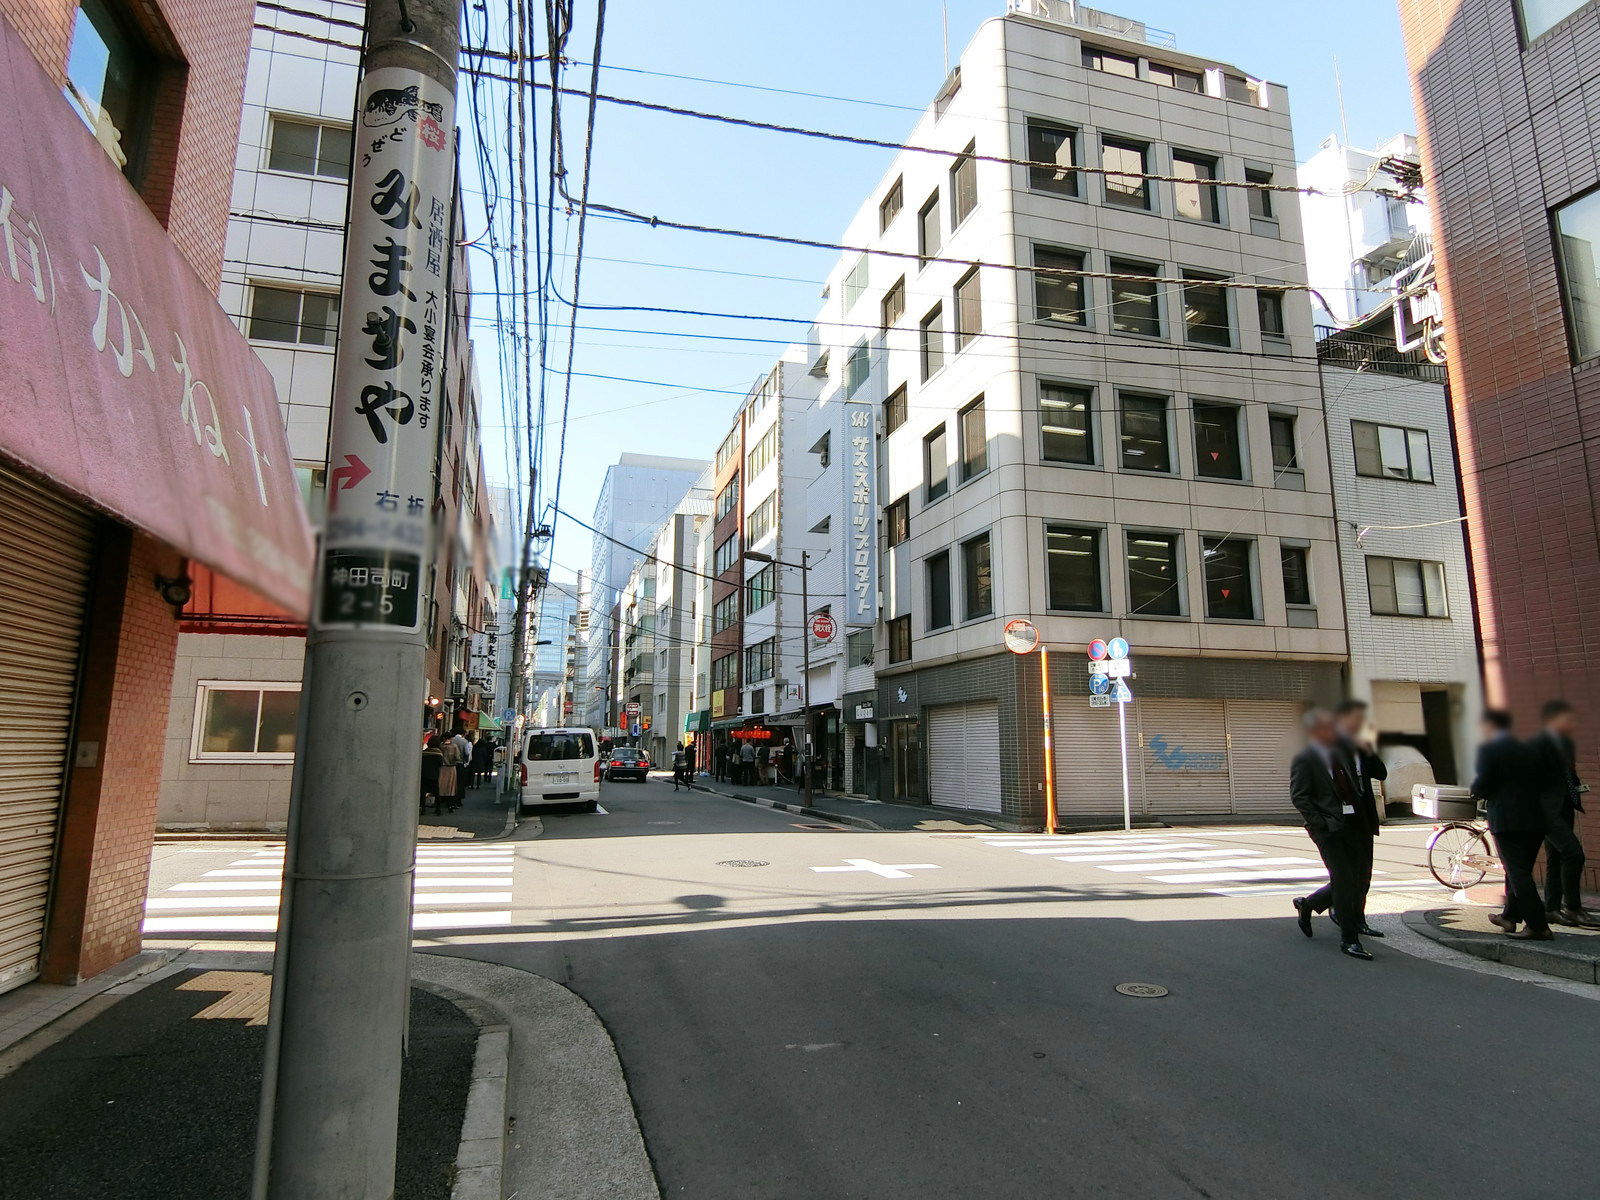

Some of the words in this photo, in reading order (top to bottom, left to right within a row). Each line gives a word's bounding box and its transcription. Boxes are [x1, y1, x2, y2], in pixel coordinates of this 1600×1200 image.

[425, 195, 445, 278] 居酒屋
[355, 168, 424, 444] みますや
[419, 290, 438, 430] 大小宴会承ります
[851, 410, 870, 428] SAS
[814, 623, 832, 633] 消火栓
